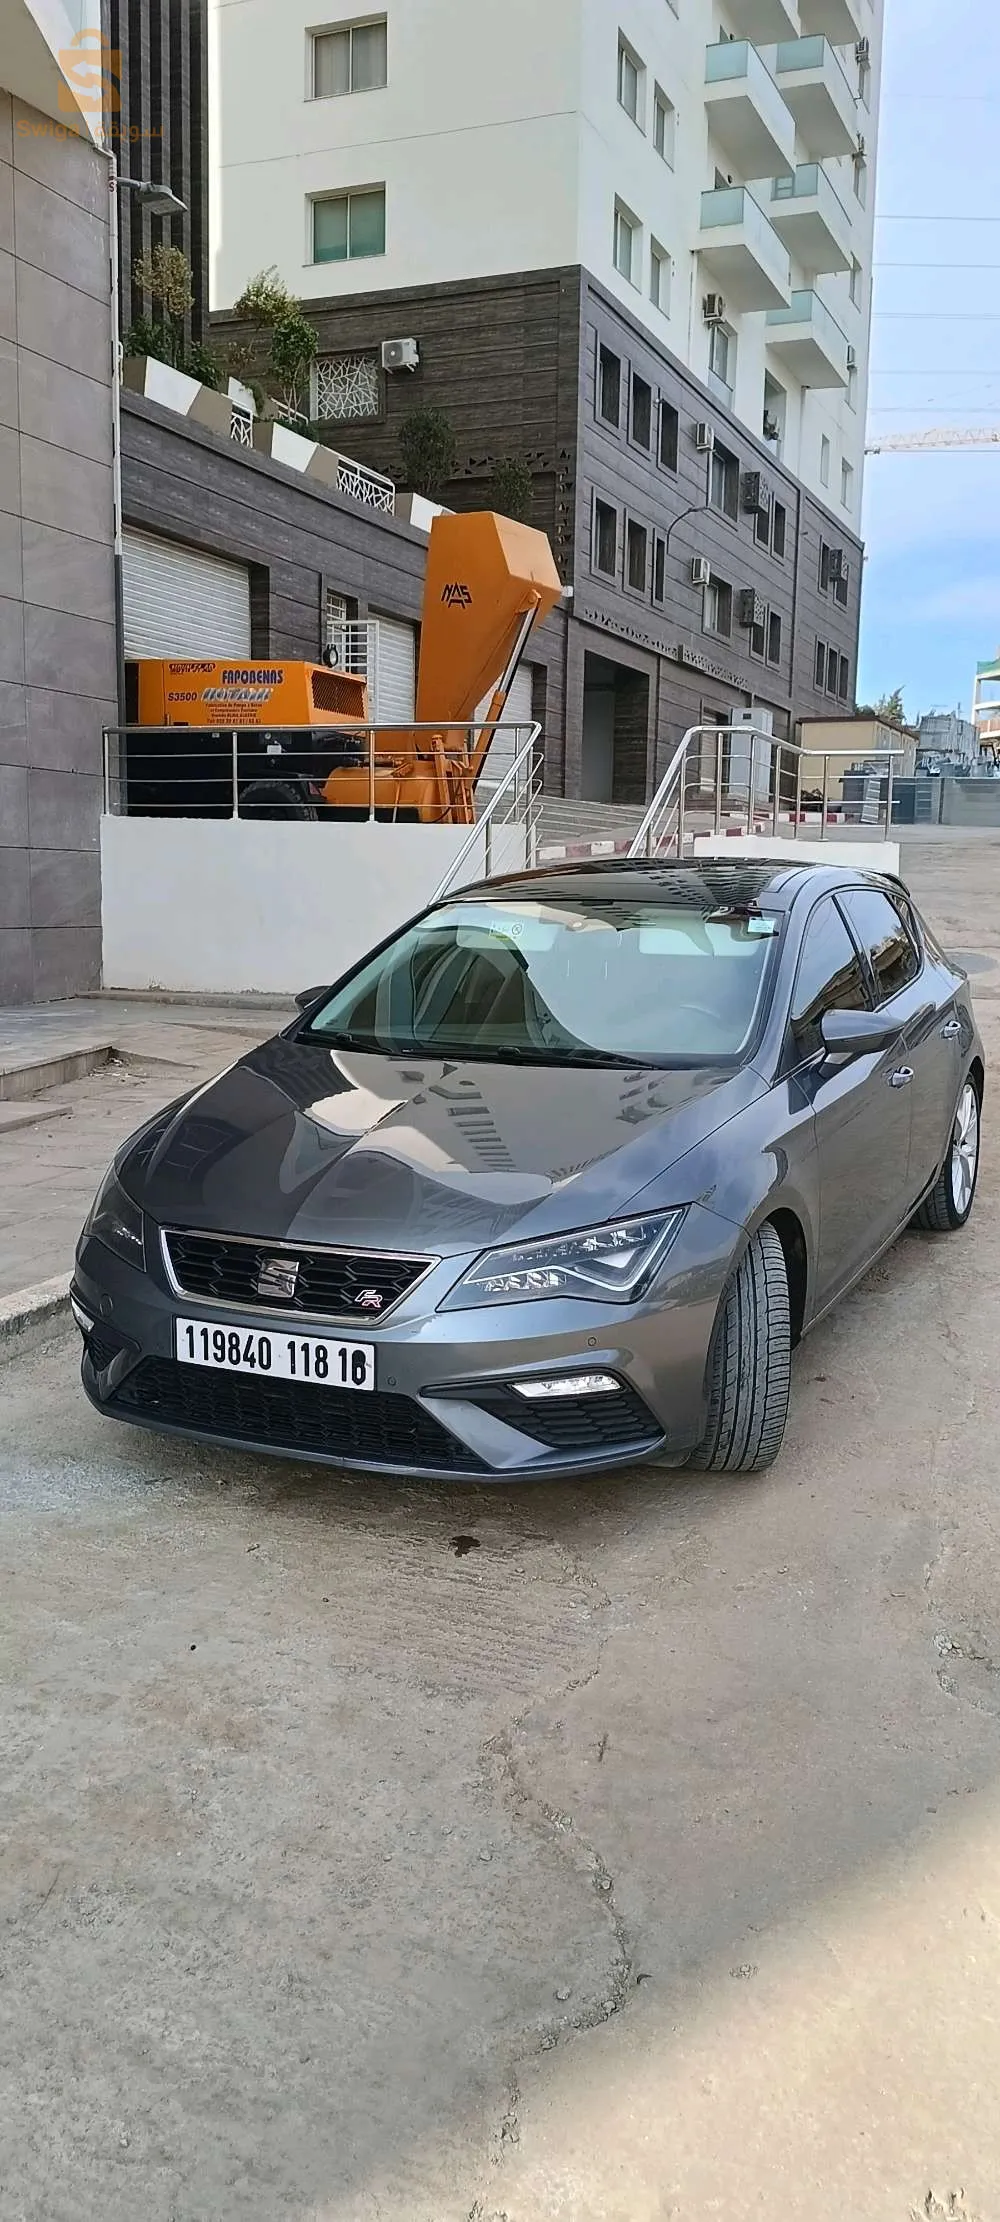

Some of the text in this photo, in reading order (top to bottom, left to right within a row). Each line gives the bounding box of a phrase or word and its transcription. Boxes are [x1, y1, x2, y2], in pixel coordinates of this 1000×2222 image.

[441, 581, 472, 609] NAS
[168, 692, 197, 702] S3500
[185, 1325, 272, 1371] 119840
[287, 1340, 329, 1379] 118
